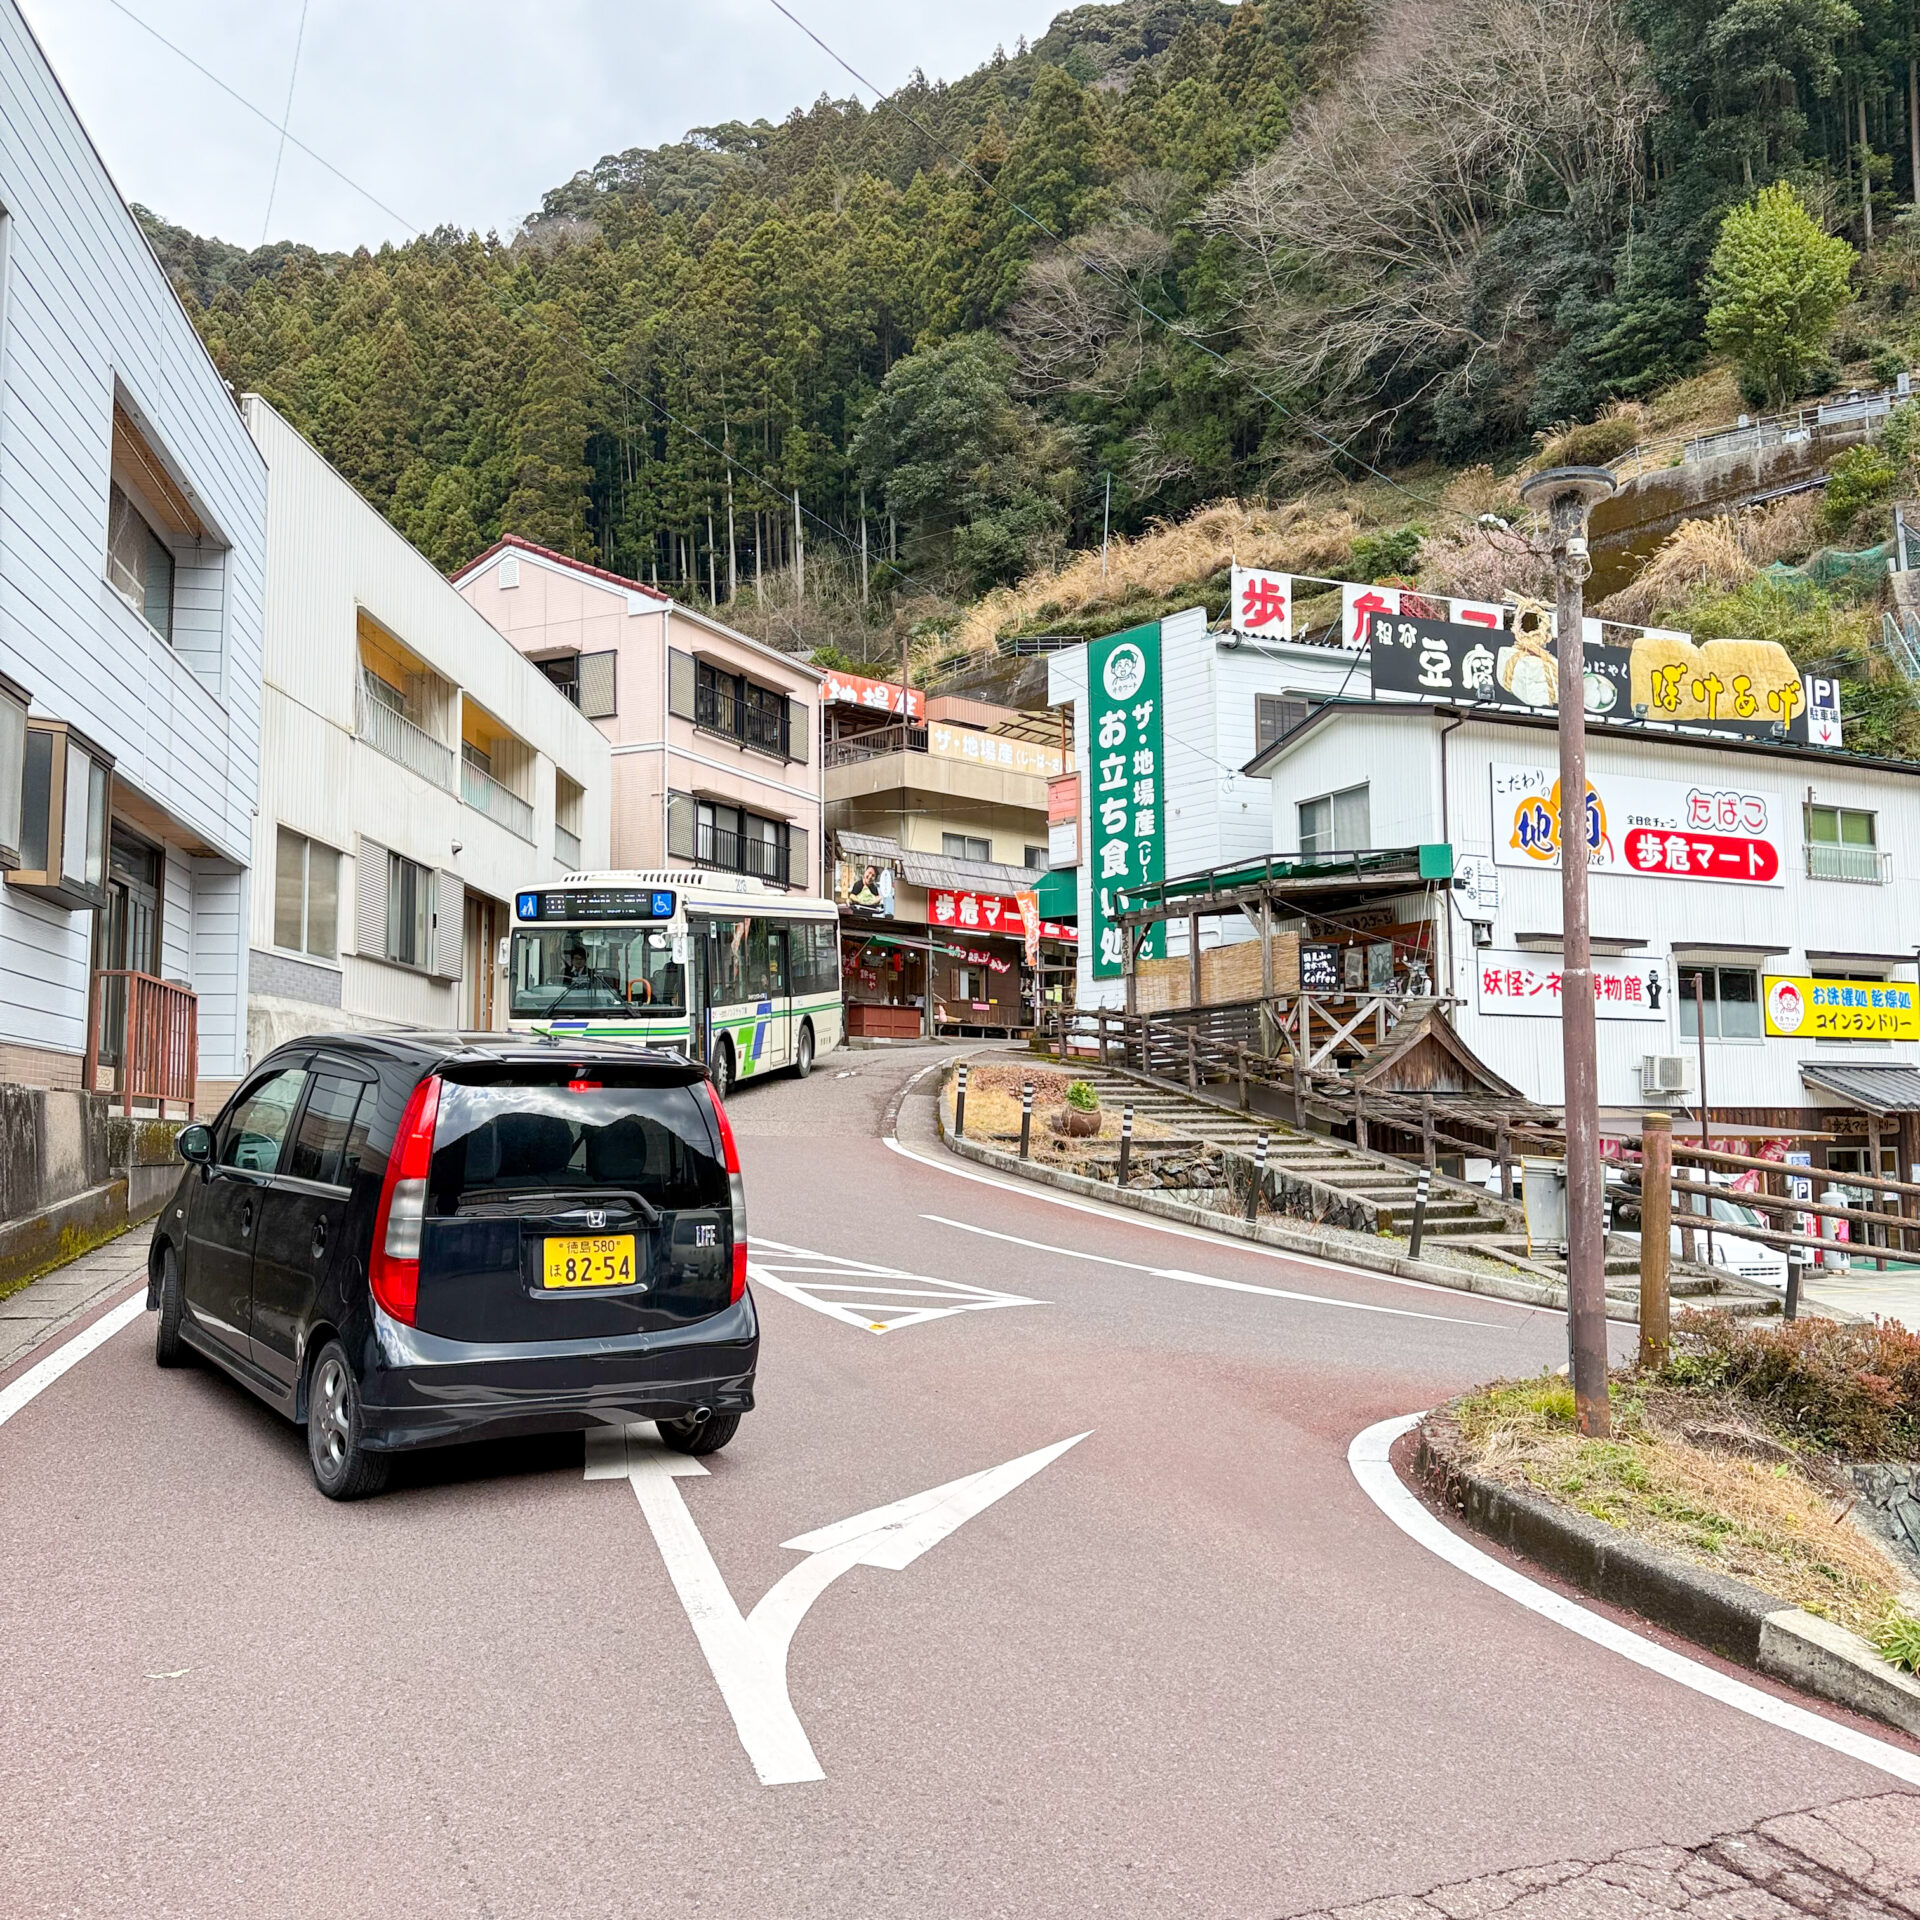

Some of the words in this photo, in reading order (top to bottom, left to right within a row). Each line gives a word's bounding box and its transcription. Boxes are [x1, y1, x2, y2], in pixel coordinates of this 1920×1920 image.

[1418, 637, 1495, 689] 豆腐
[1584, 655, 1628, 686] んにゃく
[1814, 679, 1831, 706] P
[1809, 706, 1840, 724] 駐車場
[1626, 814, 1678, 829] 全日食チェーン
[1691, 794, 1763, 828] たばこ
[1636, 833, 1765, 876] 歩危マート
[1303, 971, 1337, 984] Coffee
[1812, 986, 1868, 1007] お洗濯処
[1871, 989, 1912, 1009] 乾燥処
[1816, 1012, 1912, 1032] コインランドリー
[1798, 1183, 1807, 1199] P
[567, 1241, 591, 1254] 徳島
[593, 1240, 615, 1253] 580
[696, 1225, 716, 1248] LIFE
[566, 1256, 630, 1282] 82-54
